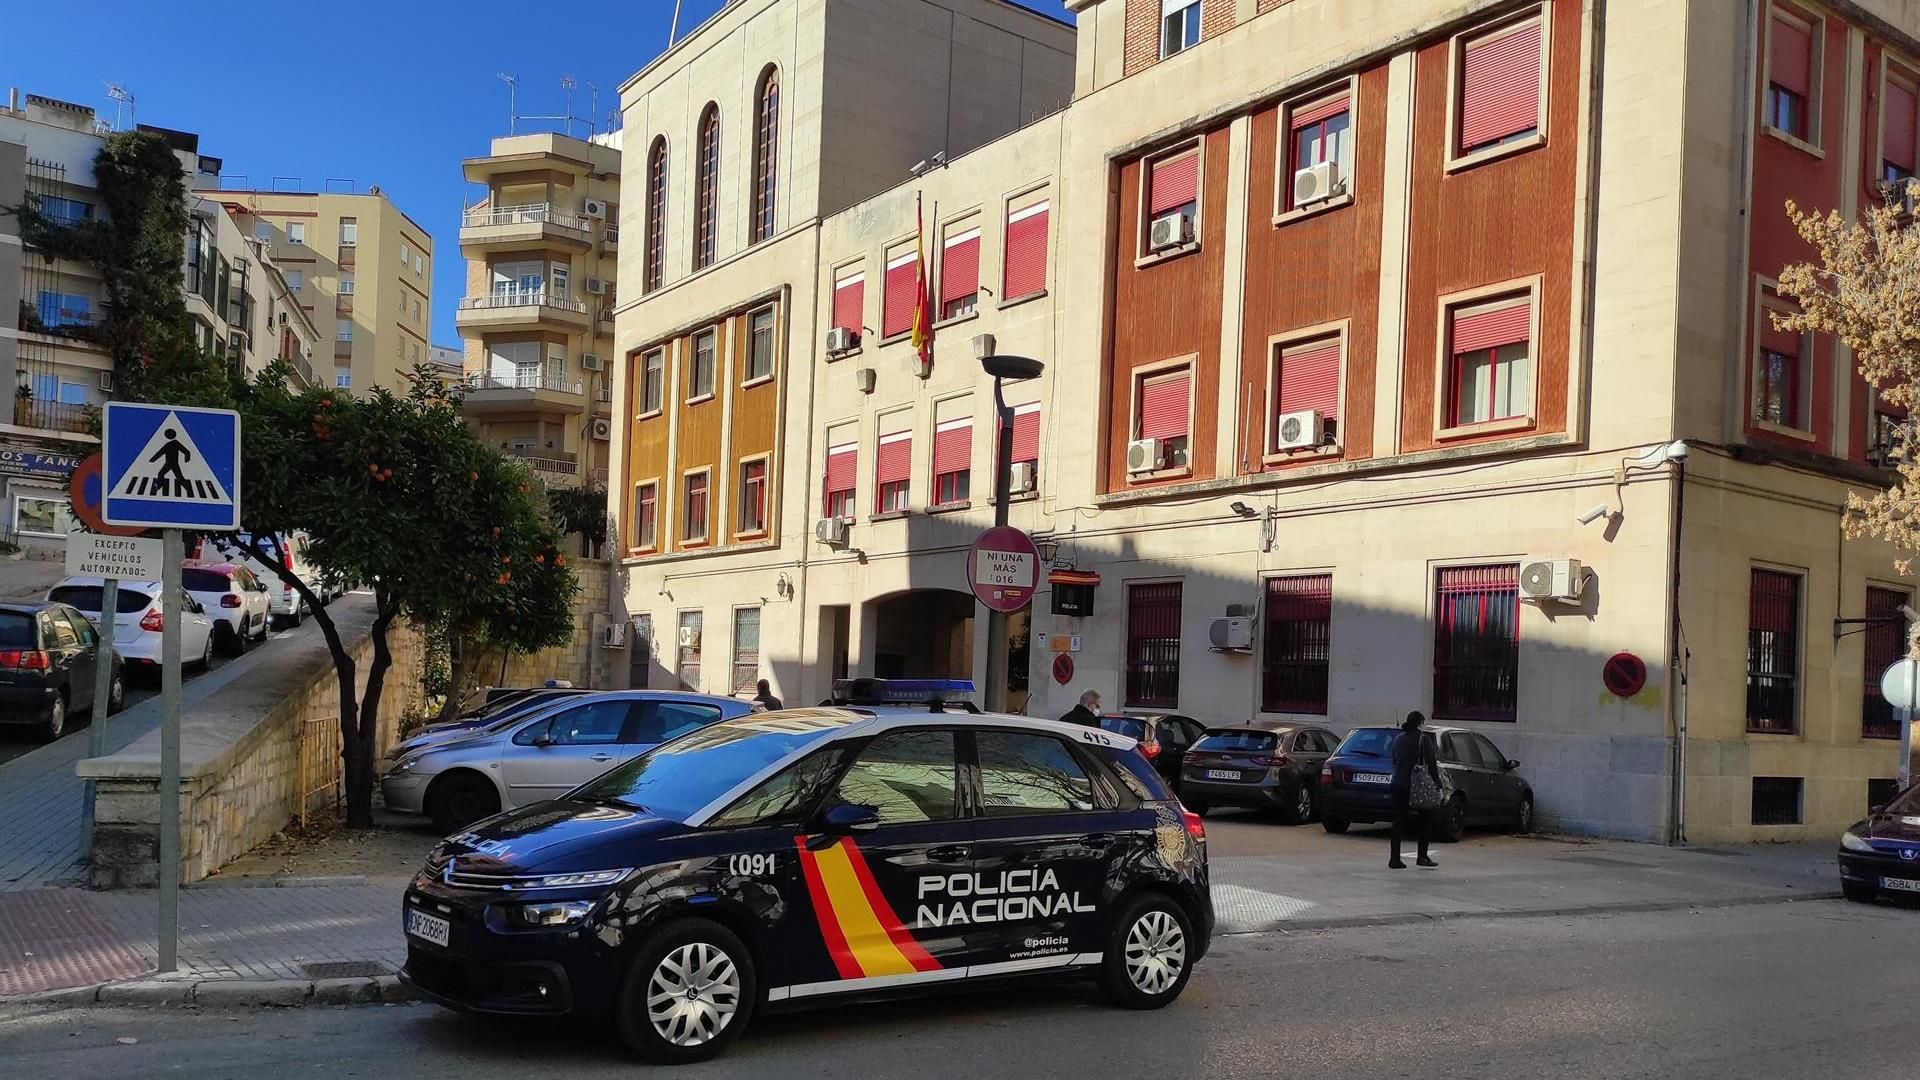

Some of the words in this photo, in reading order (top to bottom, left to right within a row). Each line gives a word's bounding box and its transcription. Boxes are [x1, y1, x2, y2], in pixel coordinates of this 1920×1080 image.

[95, 539, 136, 551] EXCEPTO
[88, 551, 142, 564] VEHICULOS
[987, 552, 998, 561] NI
[1001, 553, 1024, 563] UNA
[80, 563, 146, 577] AUTORIZADOS
[993, 562, 1017, 574] MÁS
[995, 575, 1014, 584] 016
[738, 853, 775, 876] 091
[918, 864, 1060, 900] POLICÍA
[917, 891, 1096, 929] NACIONAL
